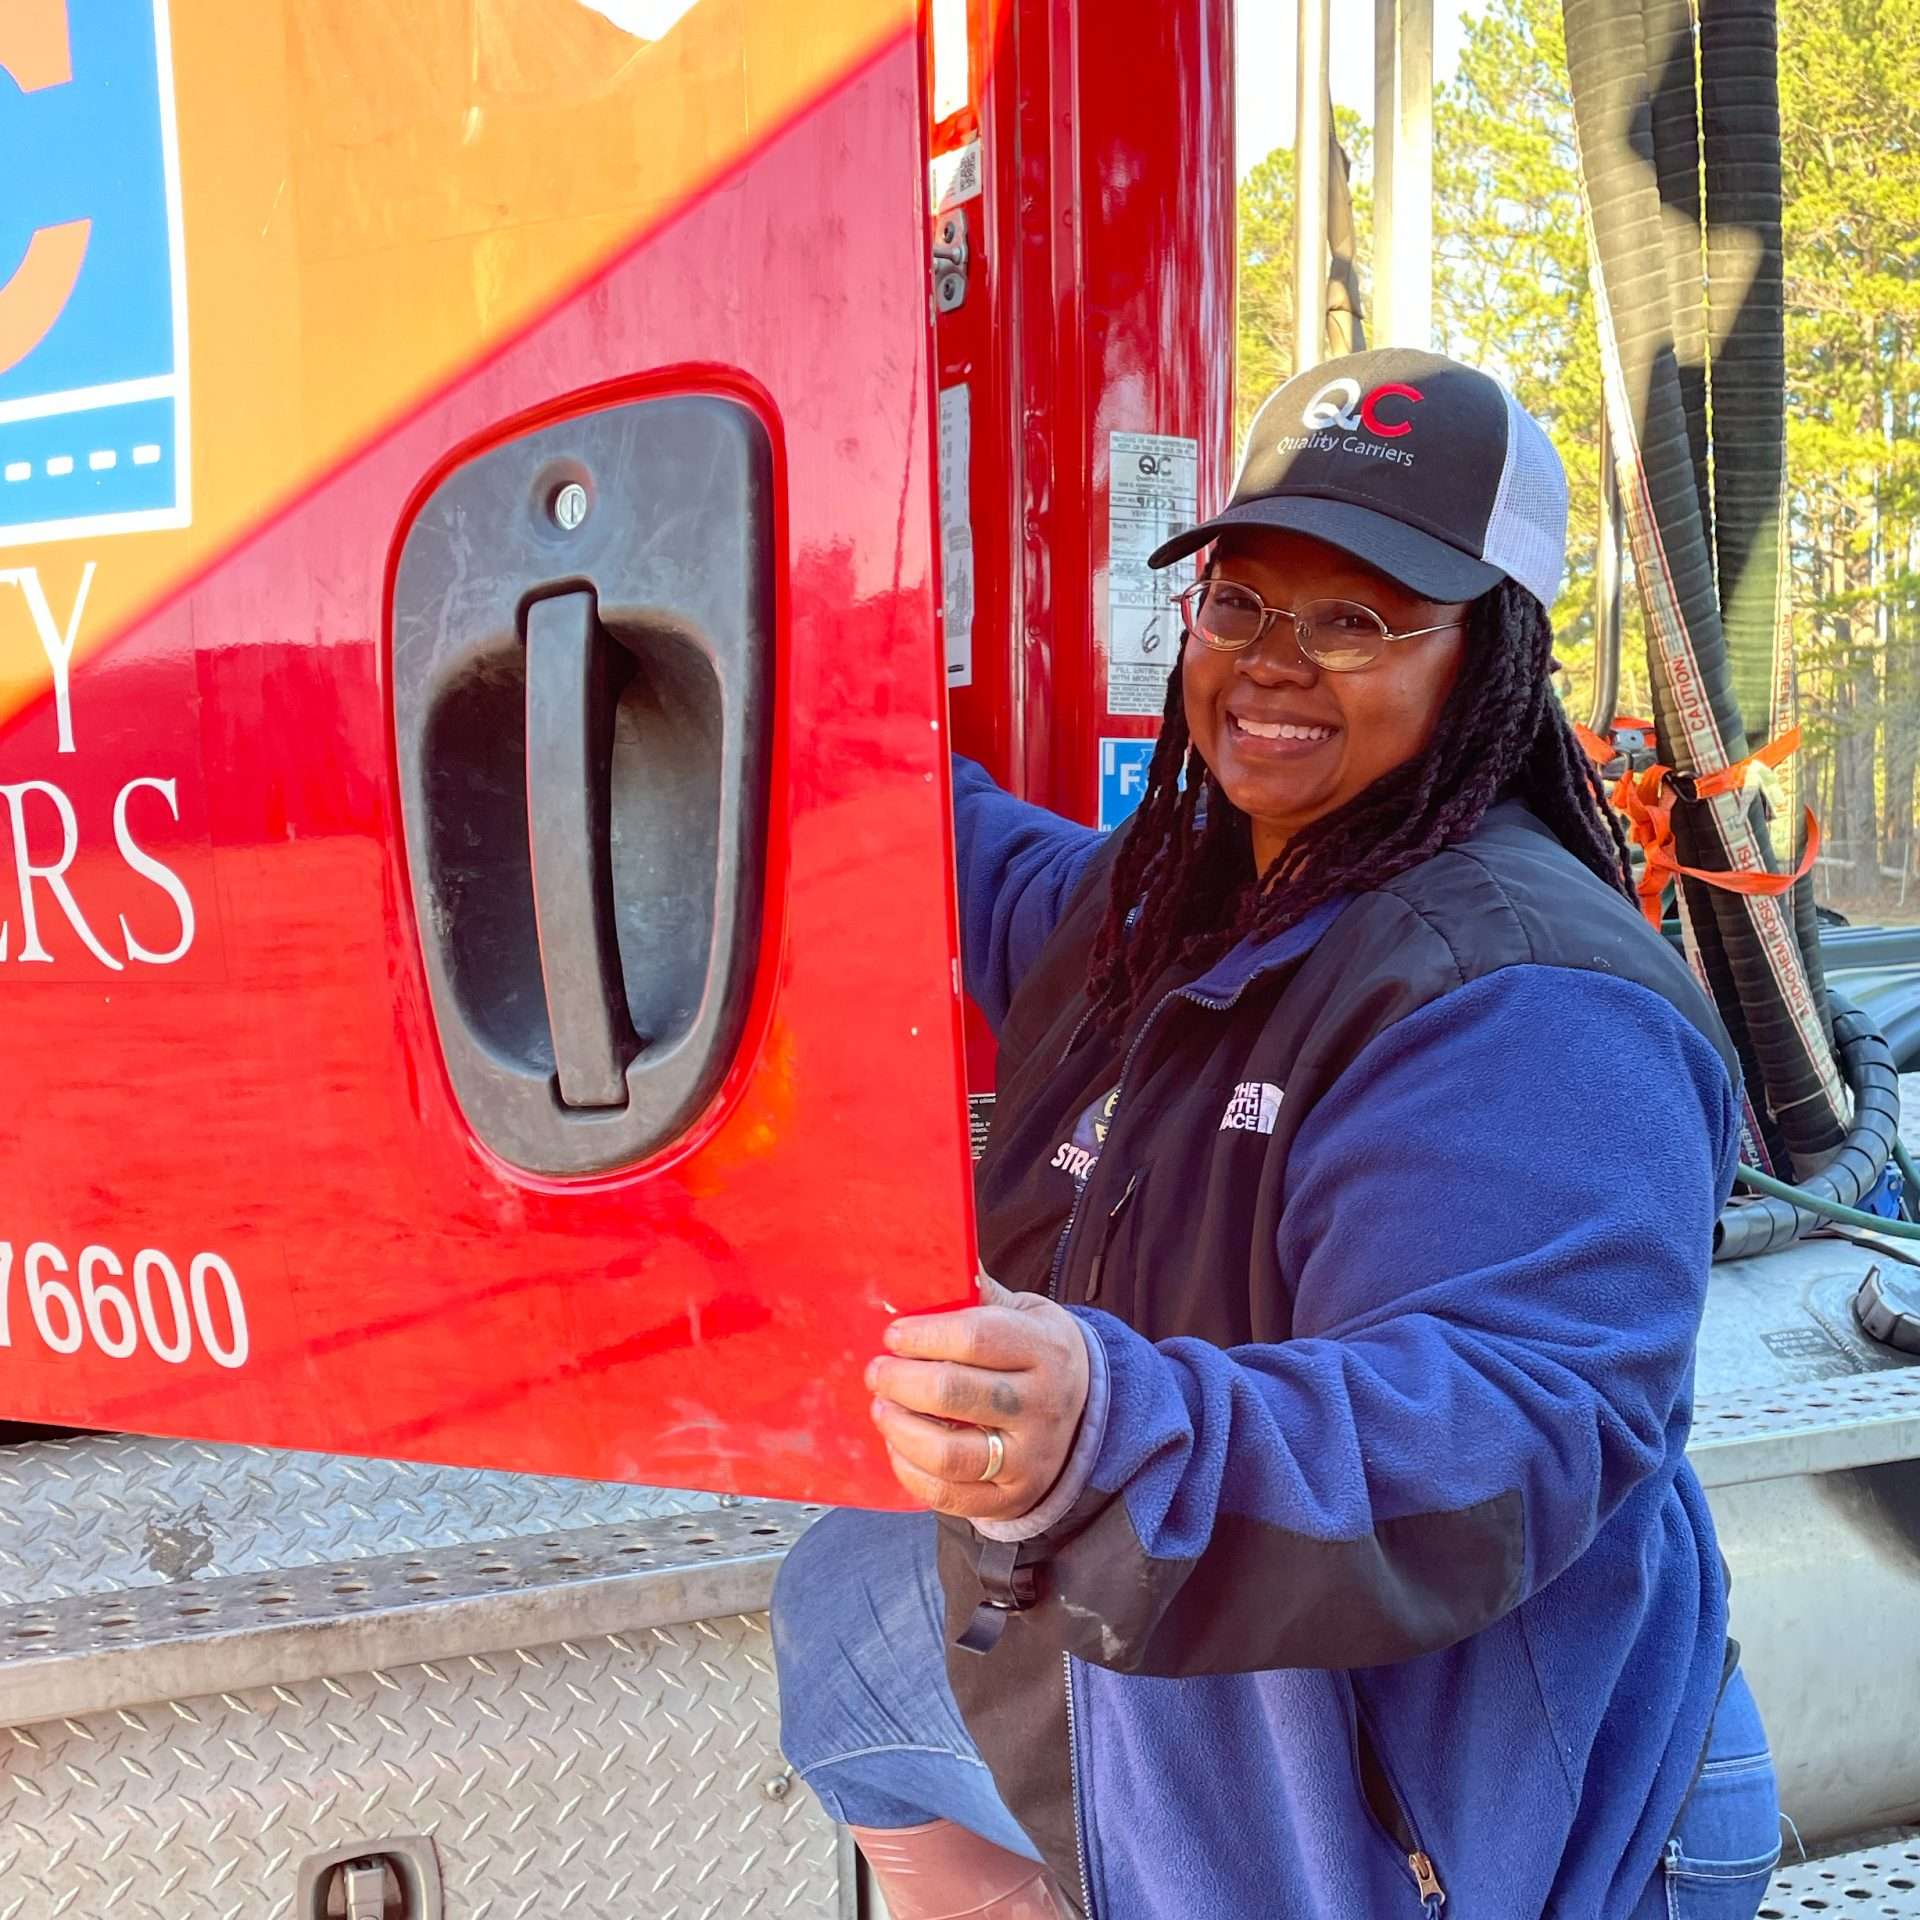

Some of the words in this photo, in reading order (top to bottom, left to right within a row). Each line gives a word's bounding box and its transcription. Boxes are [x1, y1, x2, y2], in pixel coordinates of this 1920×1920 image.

[1303, 378, 1424, 438] QC
[1138, 454, 1172, 477] QC
[1277, 431, 1339, 455] Quality
[1342, 436, 1415, 467] Carriers
[1141, 615, 1161, 654] 6
[0, 778, 196, 971] RS
[1218, 1112, 1260, 1131] ACE
[1740, 1120, 1762, 1169] HEMICAL
